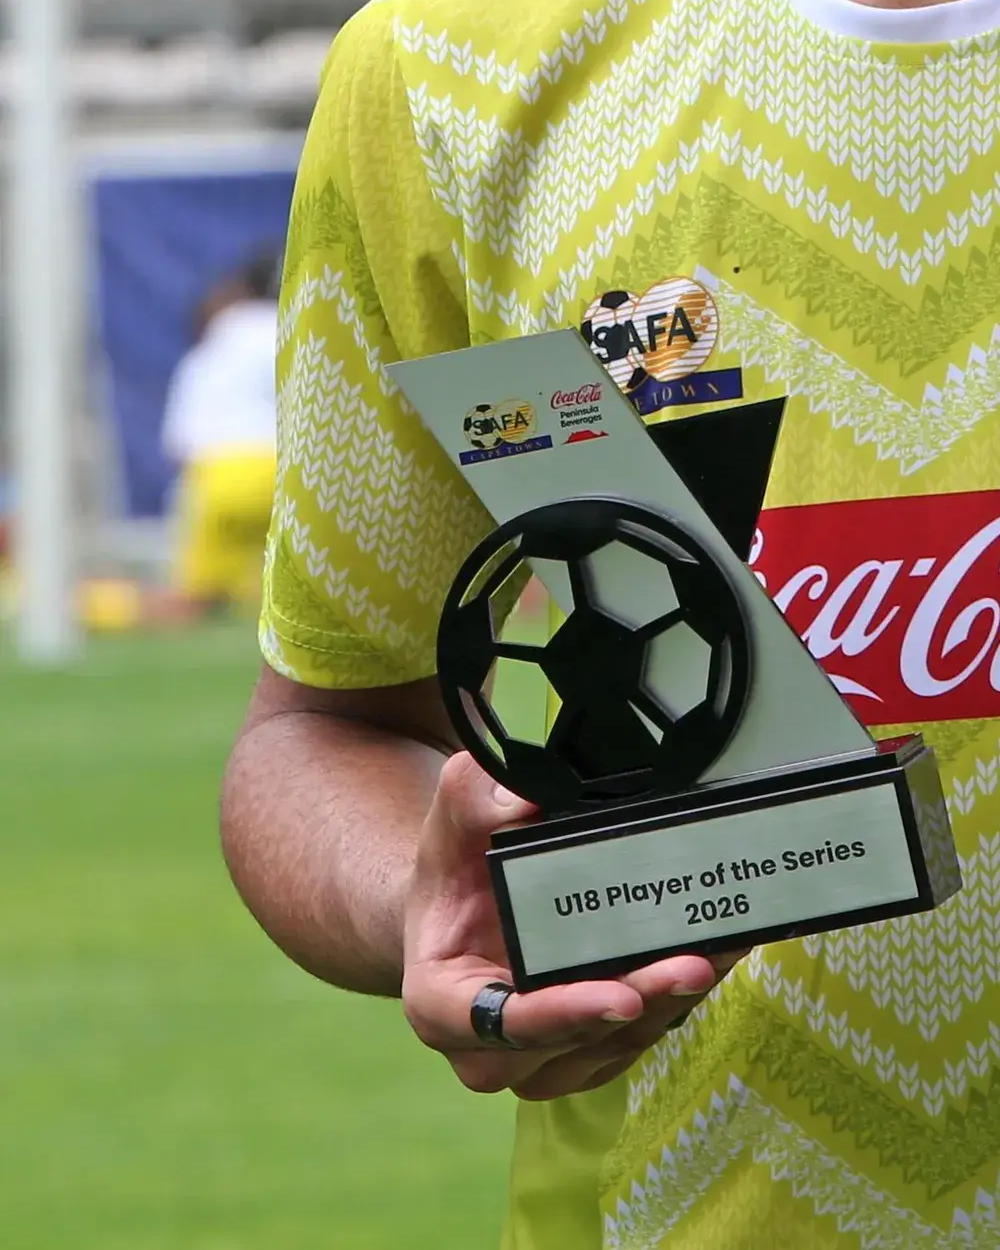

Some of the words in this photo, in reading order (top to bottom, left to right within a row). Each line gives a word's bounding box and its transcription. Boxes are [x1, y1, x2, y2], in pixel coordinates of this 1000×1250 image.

[591, 307, 698, 365] SAFA
[551, 383, 602, 410] Coca-Cola
[473, 410, 530, 436] SAFA
[560, 405, 599, 419] Peninsula
[560, 414, 603, 428] Beverages
[554, 888, 601, 917] U18
[606, 872, 694, 908] Player
[699, 861, 727, 888] of
[730, 851, 777, 883] the
[782, 840, 866, 872] Series
[684, 893, 750, 926] 2026
